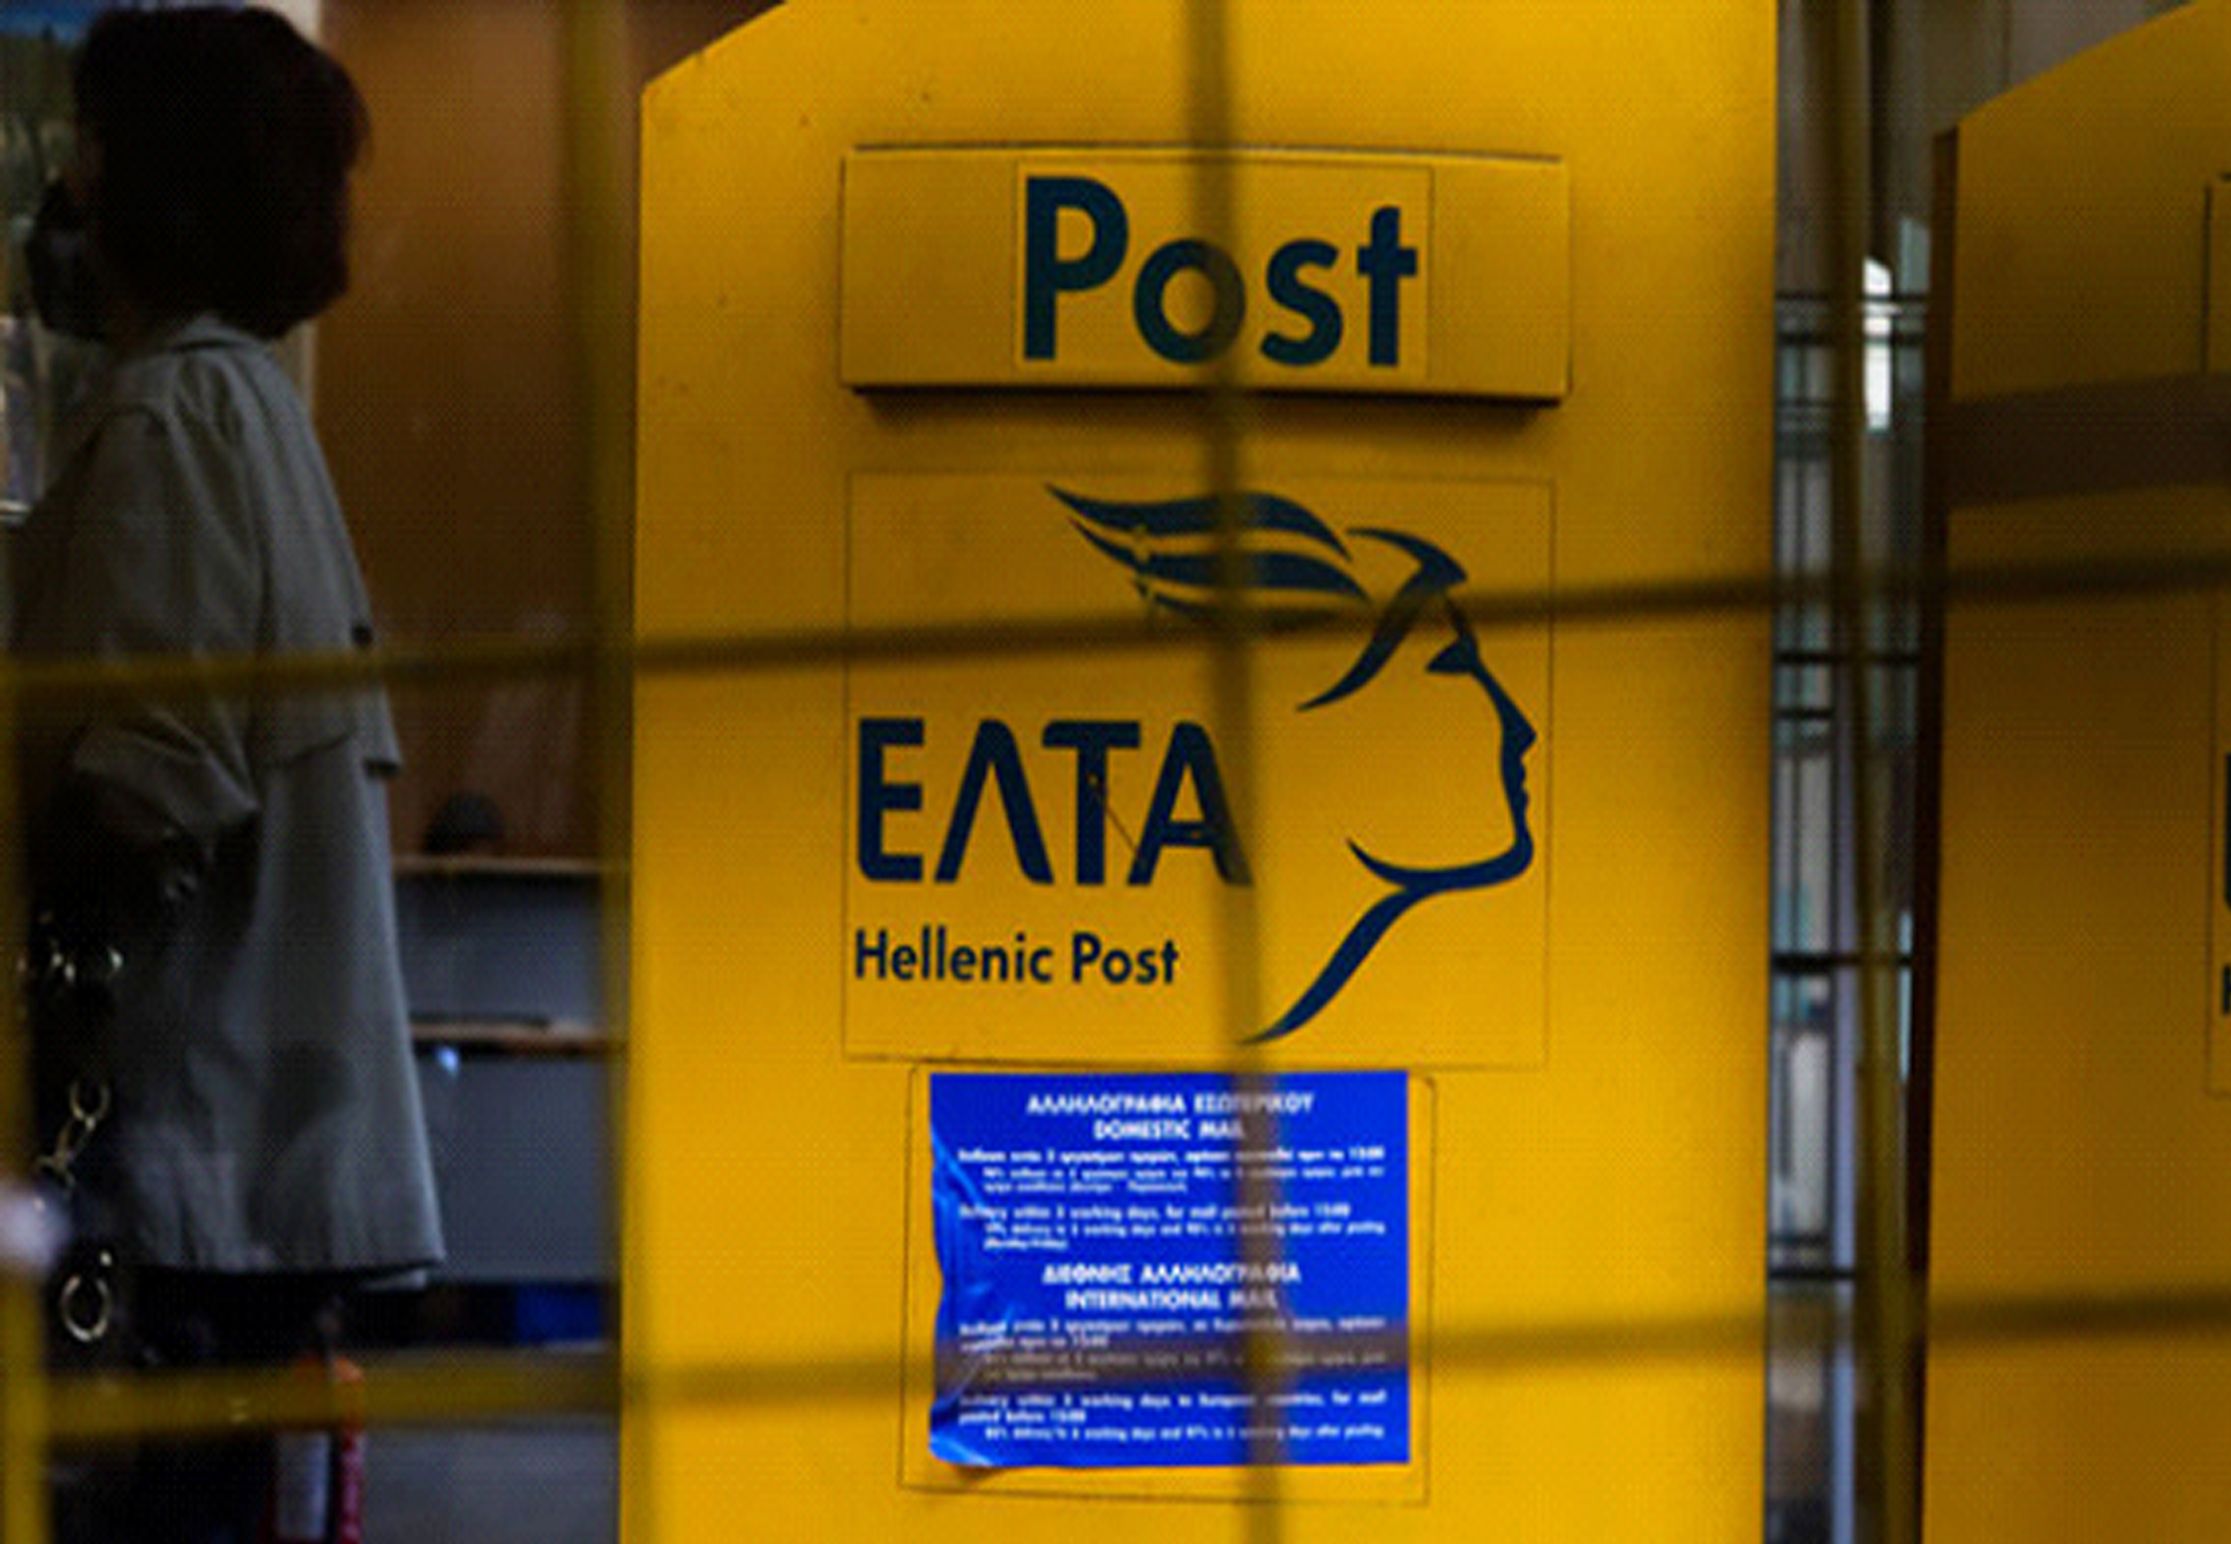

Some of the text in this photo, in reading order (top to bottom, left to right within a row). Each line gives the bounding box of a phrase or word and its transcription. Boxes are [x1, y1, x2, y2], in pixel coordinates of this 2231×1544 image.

[1023, 175, 1418, 367] Post
[857, 717, 1254, 887] ΕΛΤΑ
[855, 926, 1180, 985] Hellenic Post
[1094, 1119, 1190, 1141] DOMESTIC
[1064, 1289, 1221, 1310] INTERNATIONAL
